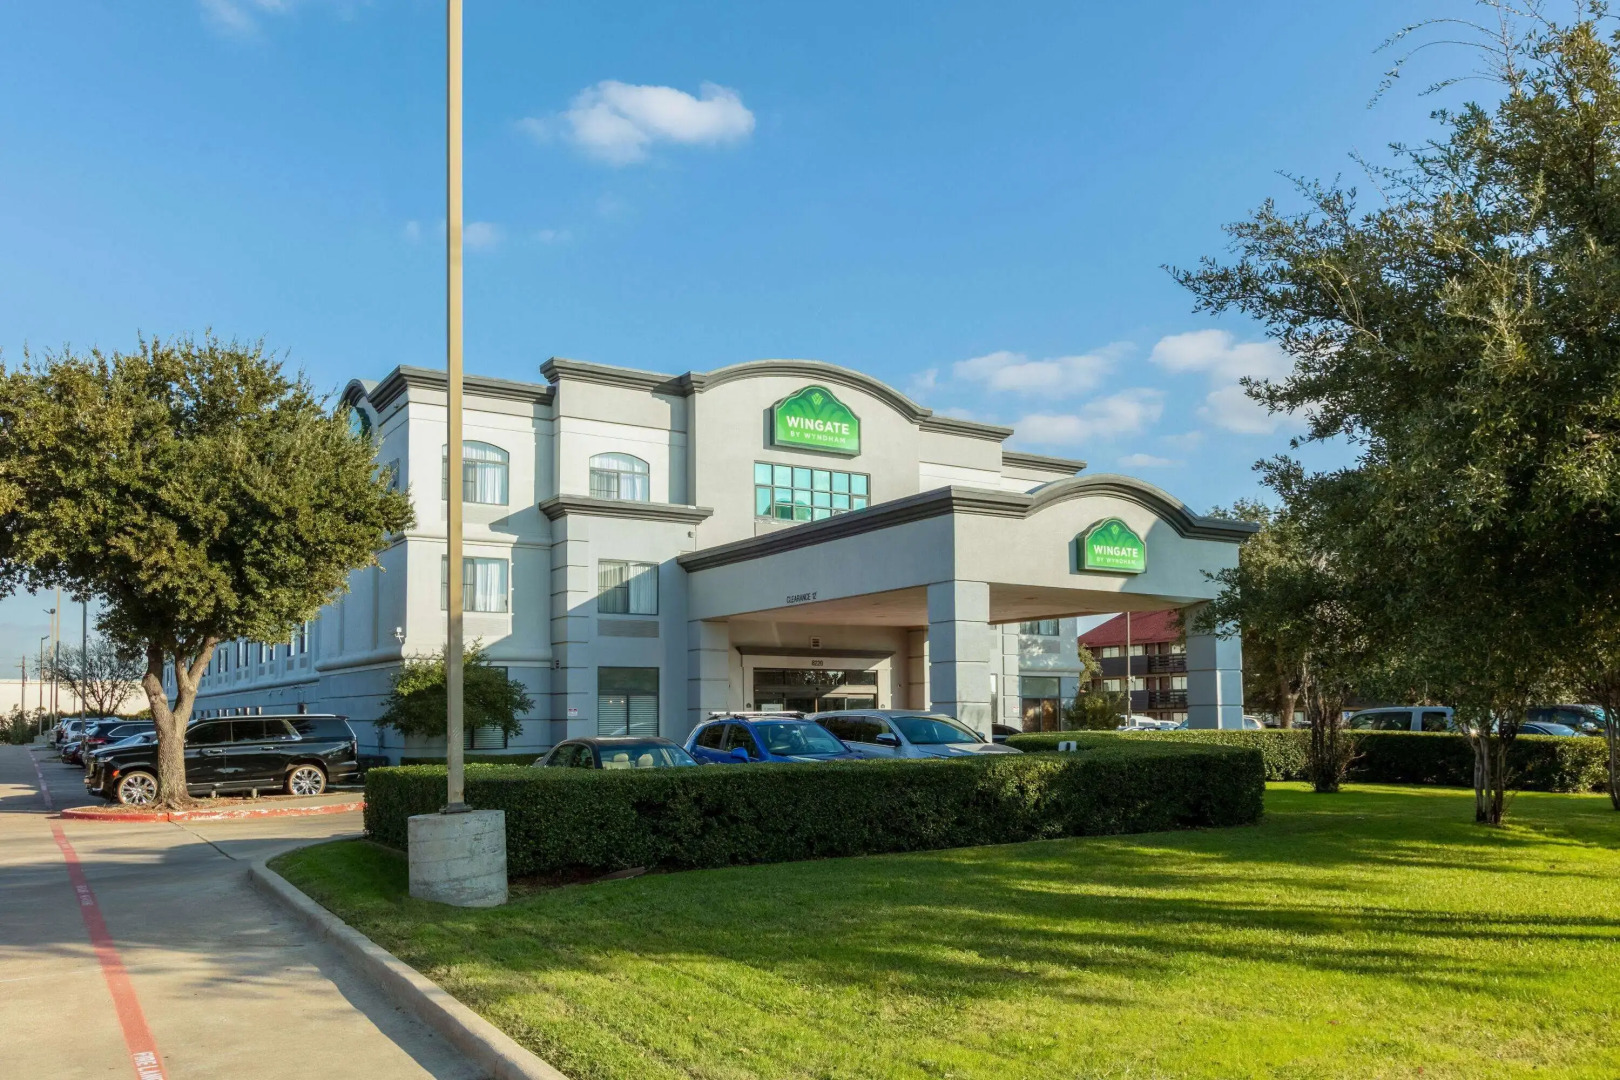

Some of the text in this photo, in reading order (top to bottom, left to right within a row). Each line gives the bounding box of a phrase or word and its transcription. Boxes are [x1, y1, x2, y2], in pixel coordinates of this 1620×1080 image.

[786, 415, 850, 435] WINGATE
[805, 432, 846, 443] WYNDHAM
[1093, 544, 1138, 558] WINGATE
[786, 592, 811, 603] CLEARANCE
